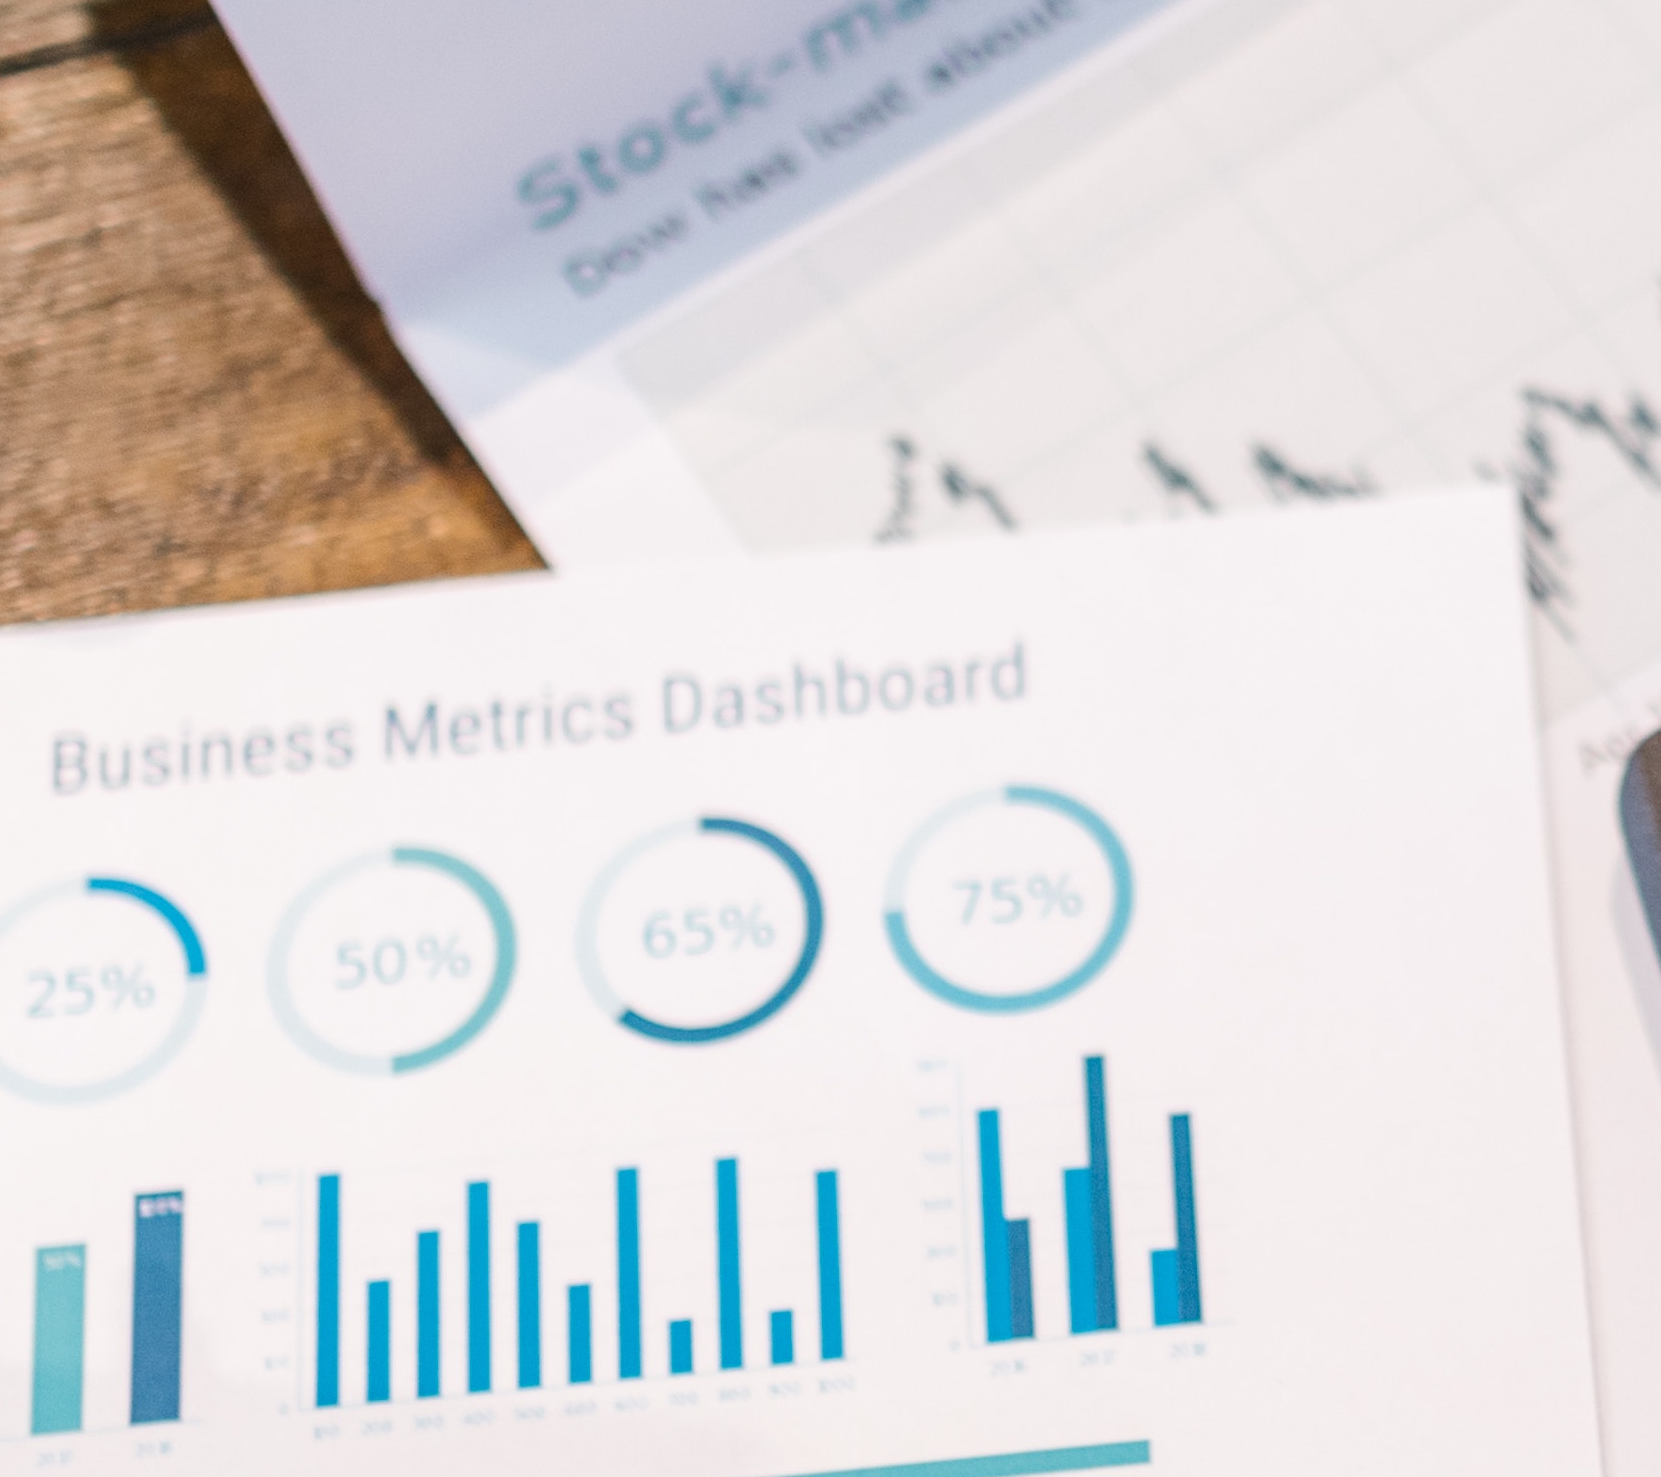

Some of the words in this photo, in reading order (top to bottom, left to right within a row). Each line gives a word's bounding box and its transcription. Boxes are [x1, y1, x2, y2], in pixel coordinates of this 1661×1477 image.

[51, 721, 356, 796] Business
[384, 694, 634, 758] Metrics
[661, 640, 1028, 735] Dashboard
[26, 964, 156, 1019] 25%
[336, 935, 472, 990] 50%
[641, 905, 776, 959] 65%
[954, 873, 1085, 925] 75%
